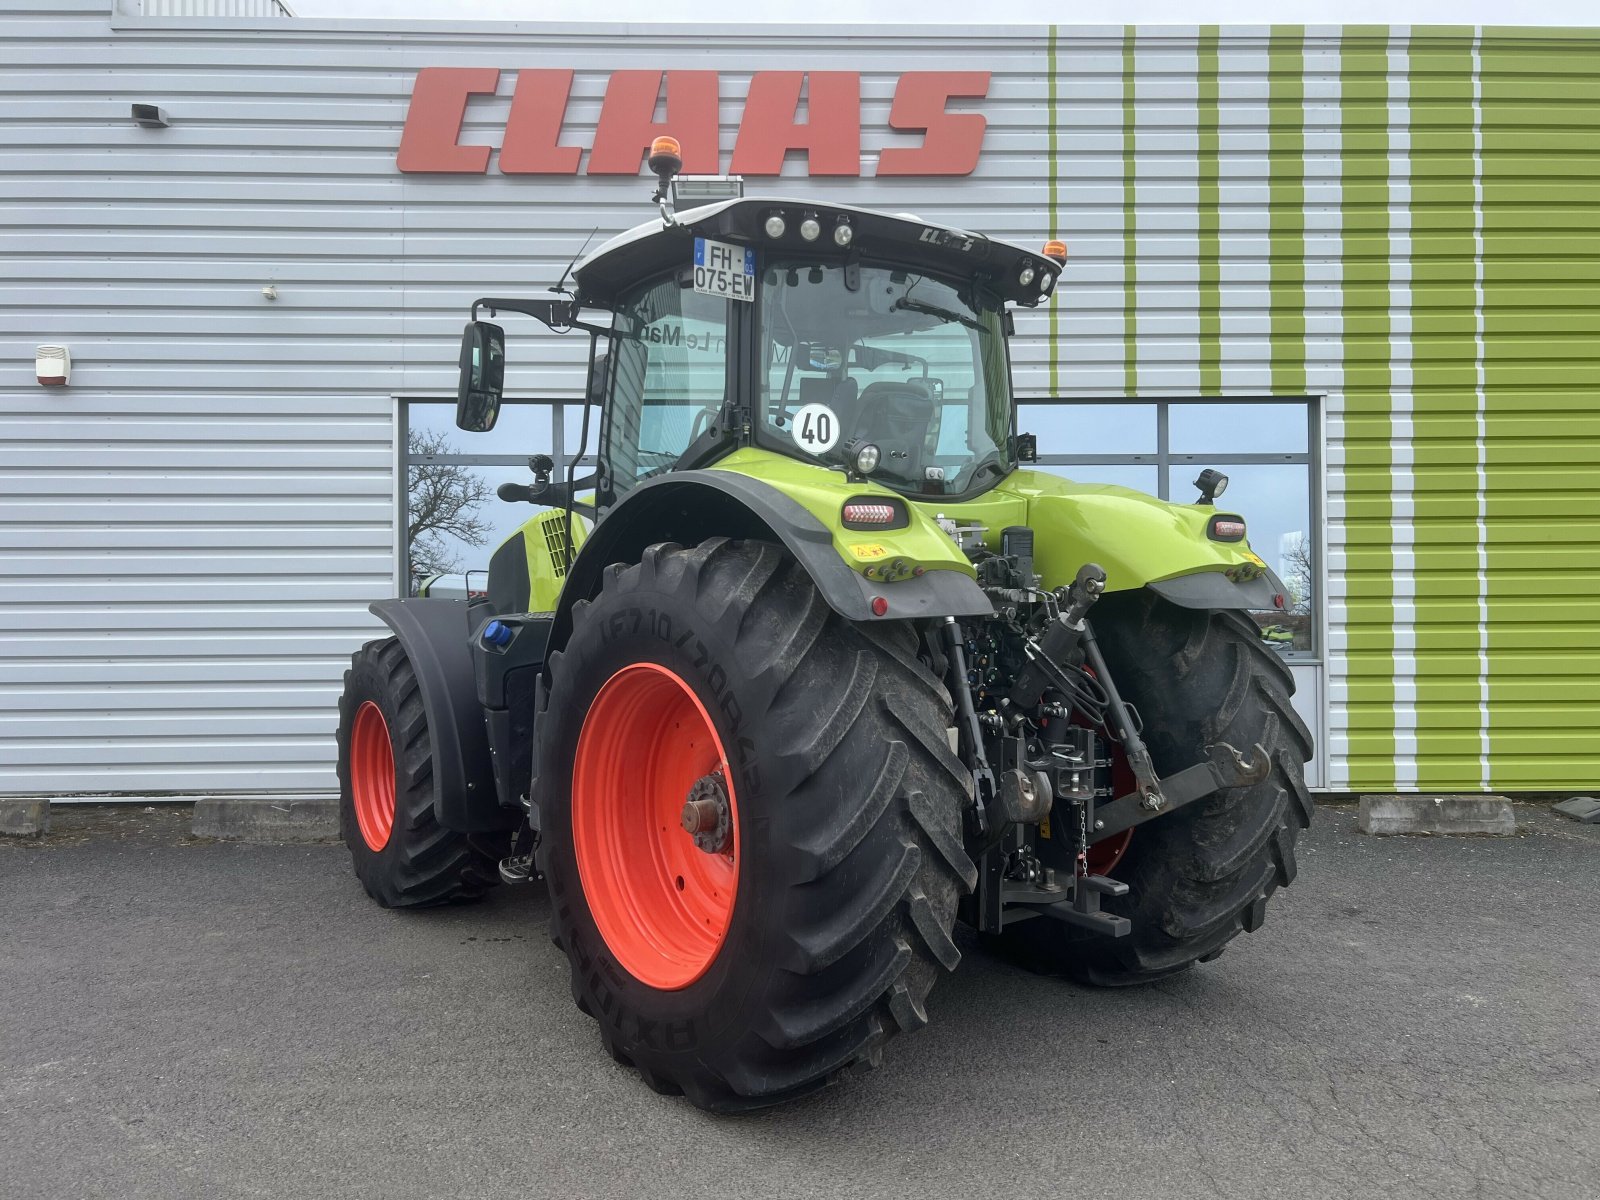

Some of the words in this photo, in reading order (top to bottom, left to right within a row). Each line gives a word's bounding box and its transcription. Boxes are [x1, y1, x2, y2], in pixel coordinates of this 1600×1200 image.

[395, 67, 992, 176] CLAAS
[919, 228, 975, 252] CLS
[695, 267, 753, 296] 075-EW
[801, 412, 831, 444] 40
